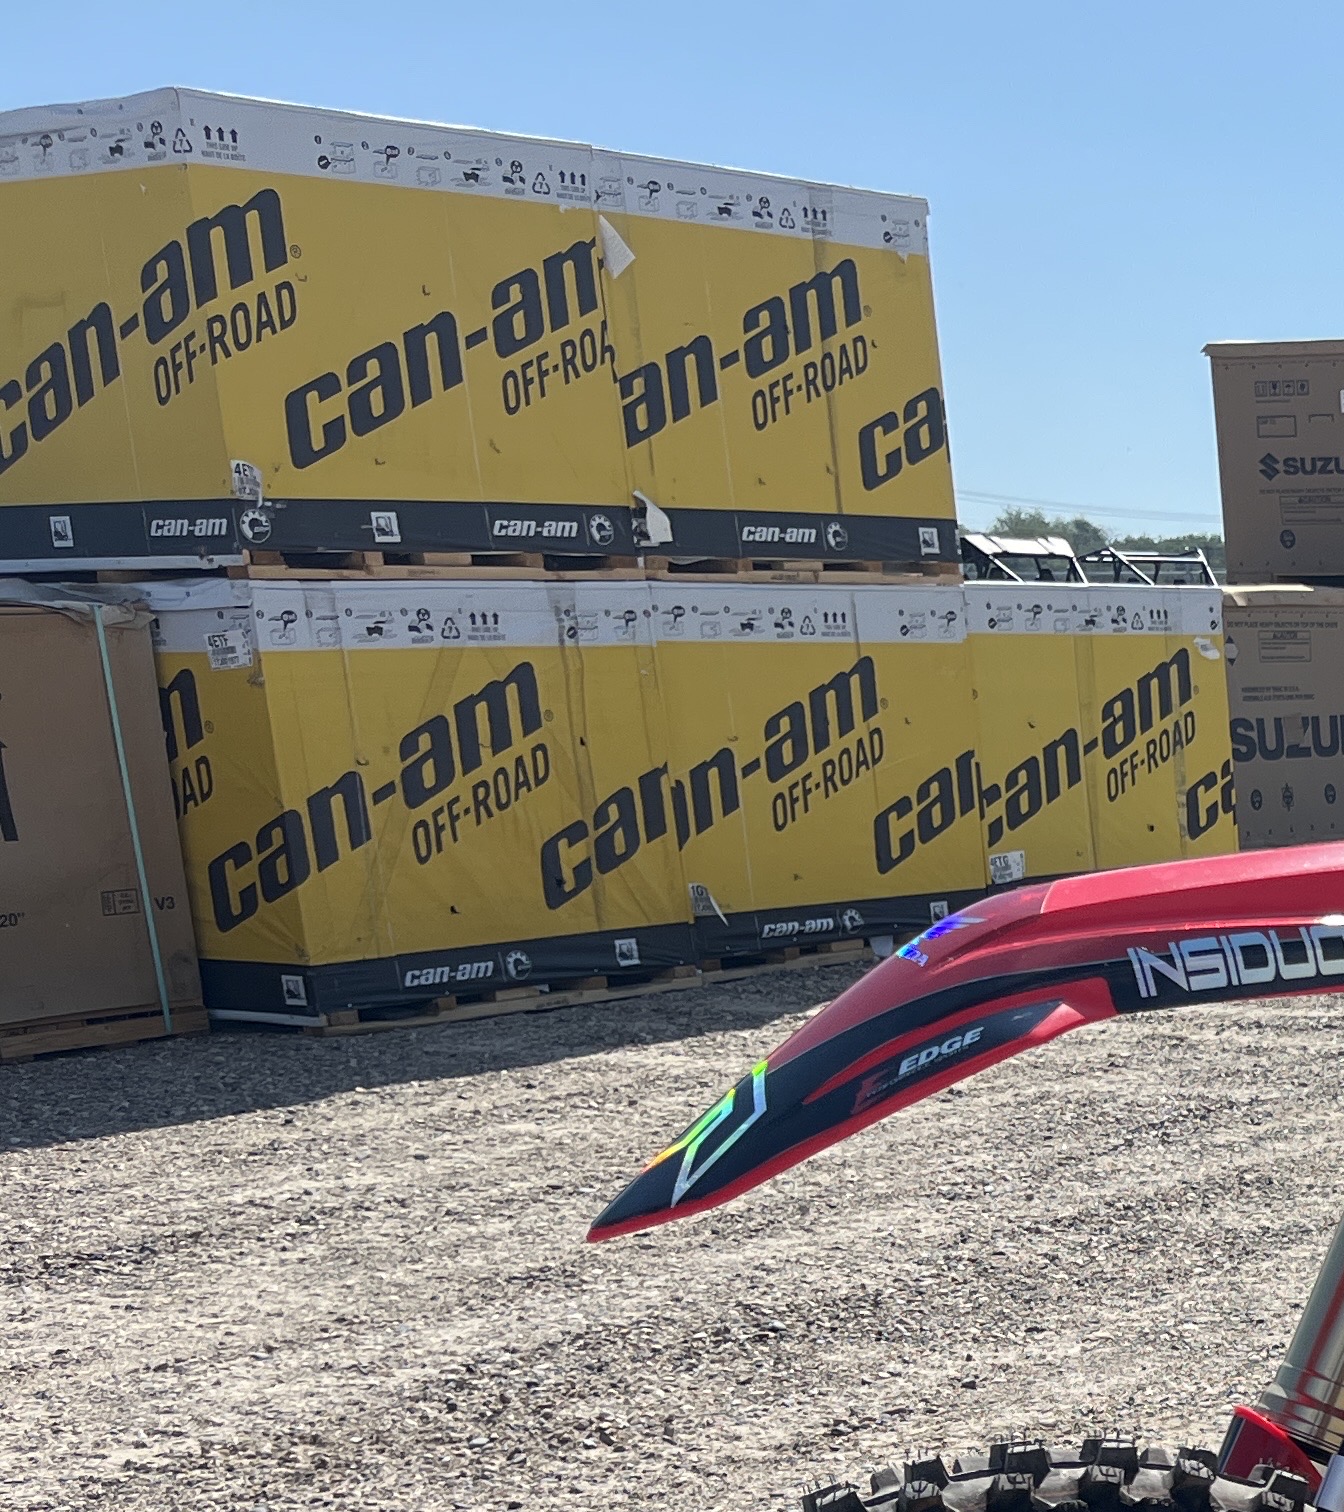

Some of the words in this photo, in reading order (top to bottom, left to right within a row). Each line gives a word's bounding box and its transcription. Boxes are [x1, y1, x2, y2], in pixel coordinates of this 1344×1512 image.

[153, 281, 297, 406] OFF-ROAD
[751, 335, 869, 431] OFF-ROAD
[150, 515, 228, 538] can-am
[493, 517, 578, 539] can-am
[742, 525, 817, 545] can-am
[772, 727, 885, 832] OFF-ROAD
[1107, 711, 1196, 803] OFF-ROAD
[208, 661, 542, 932] can-am
[412, 743, 549, 865] OFF-ROAD
[154, 896, 176, 911] V3
[761, 916, 834, 939] can-am
[404, 958, 494, 988] can-am
[898, 1026, 984, 1076] EDGE
